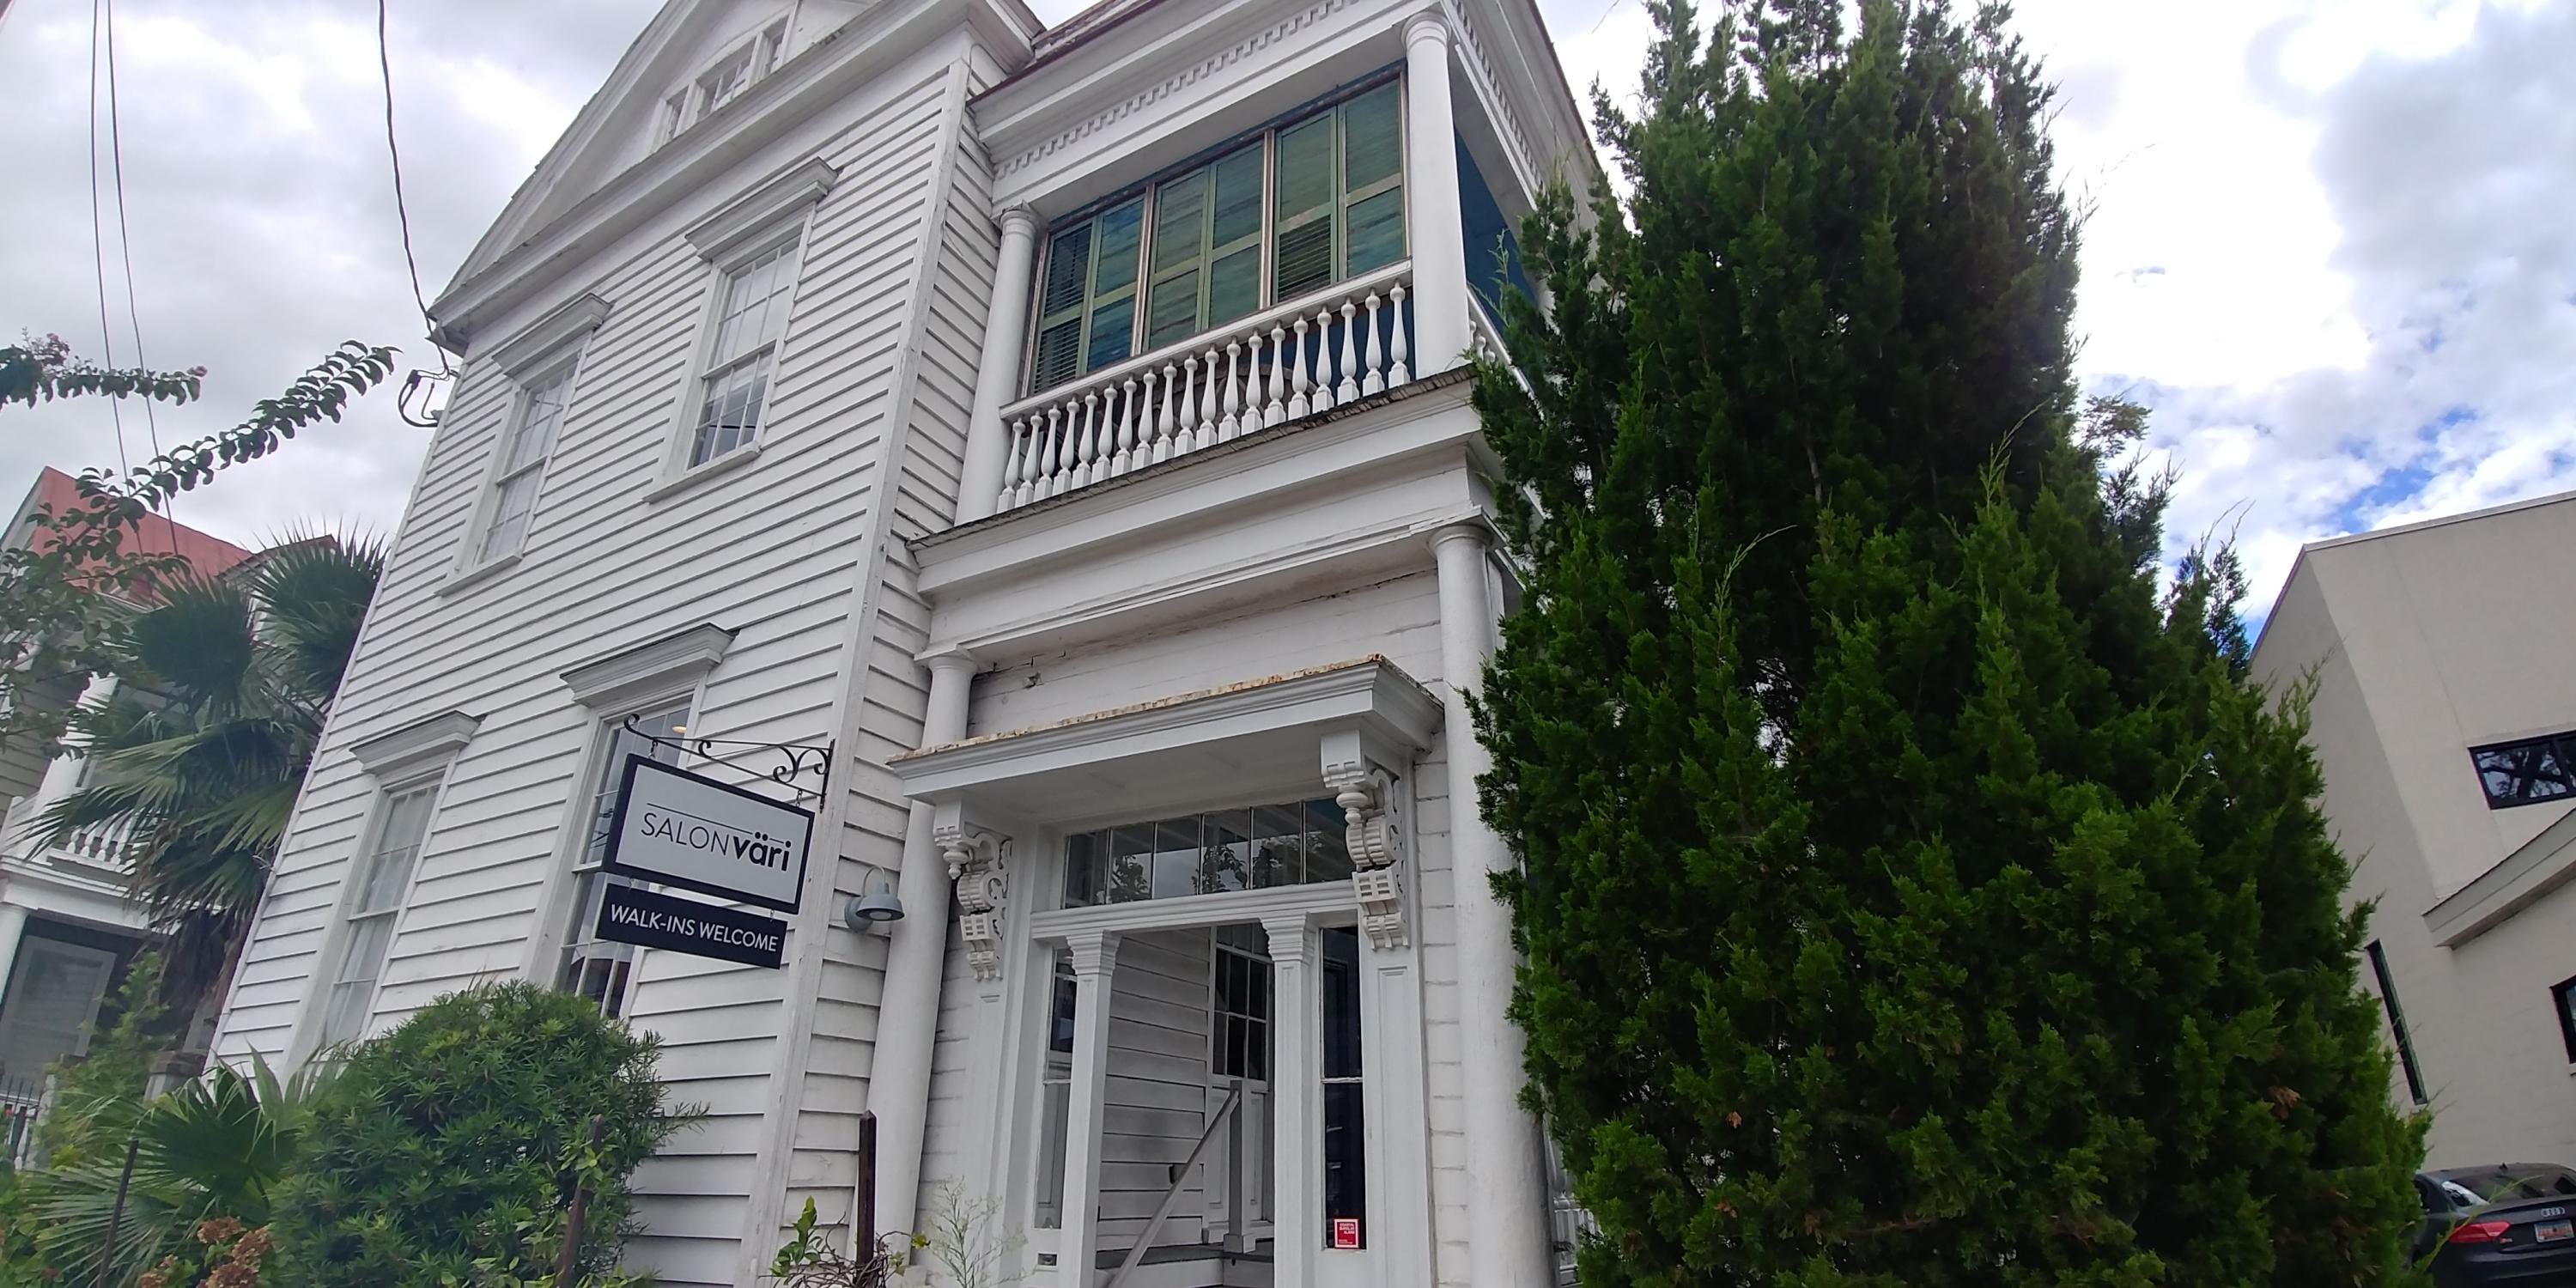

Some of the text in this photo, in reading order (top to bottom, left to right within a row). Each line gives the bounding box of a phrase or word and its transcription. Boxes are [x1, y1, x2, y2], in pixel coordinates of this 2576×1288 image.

[641, 812, 730, 856] SALON
[611, 903, 779, 952] WALK-INS WELCOME
